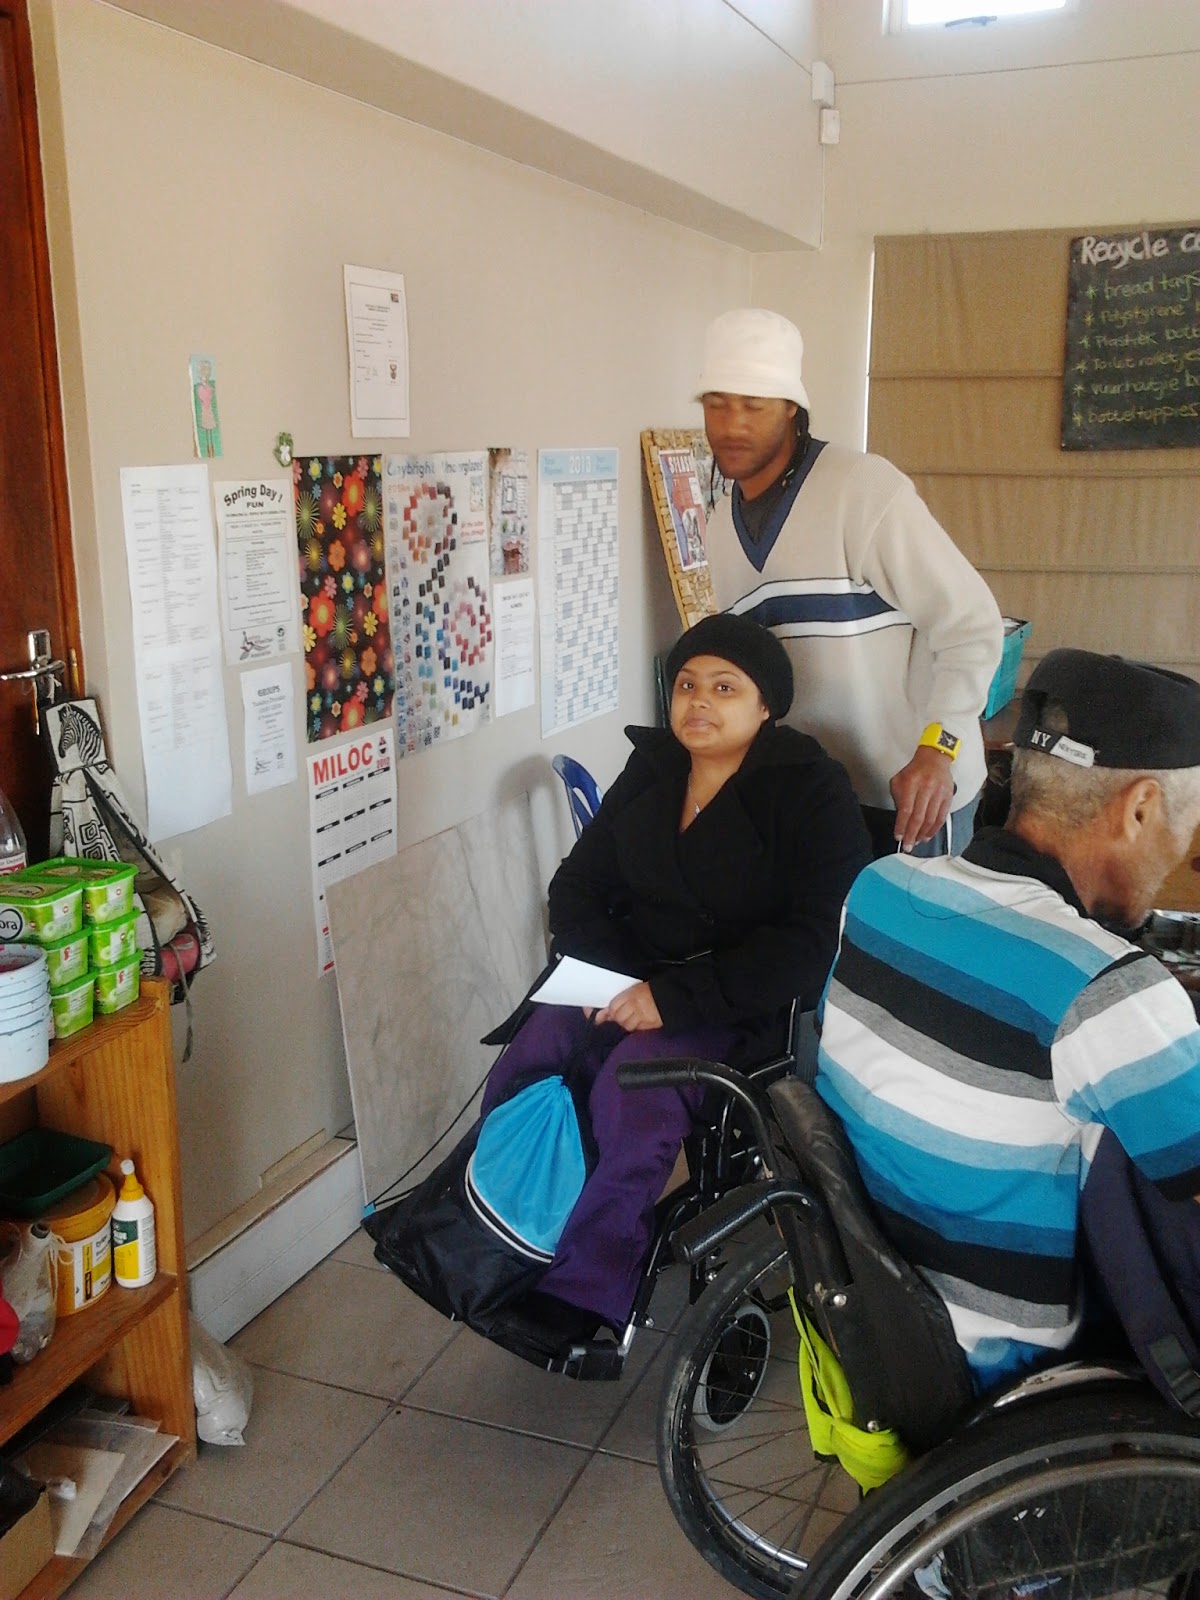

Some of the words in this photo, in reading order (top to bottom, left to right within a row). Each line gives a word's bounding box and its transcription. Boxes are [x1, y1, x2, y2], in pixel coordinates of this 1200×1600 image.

[1081, 231, 1169, 269] Recycle
[1104, 276, 1154, 300] bread
[569, 455, 592, 474] 2013
[224, 486, 258, 507] Spring
[260, 484, 278, 501] Day
[1031, 730, 1052, 747] NY
